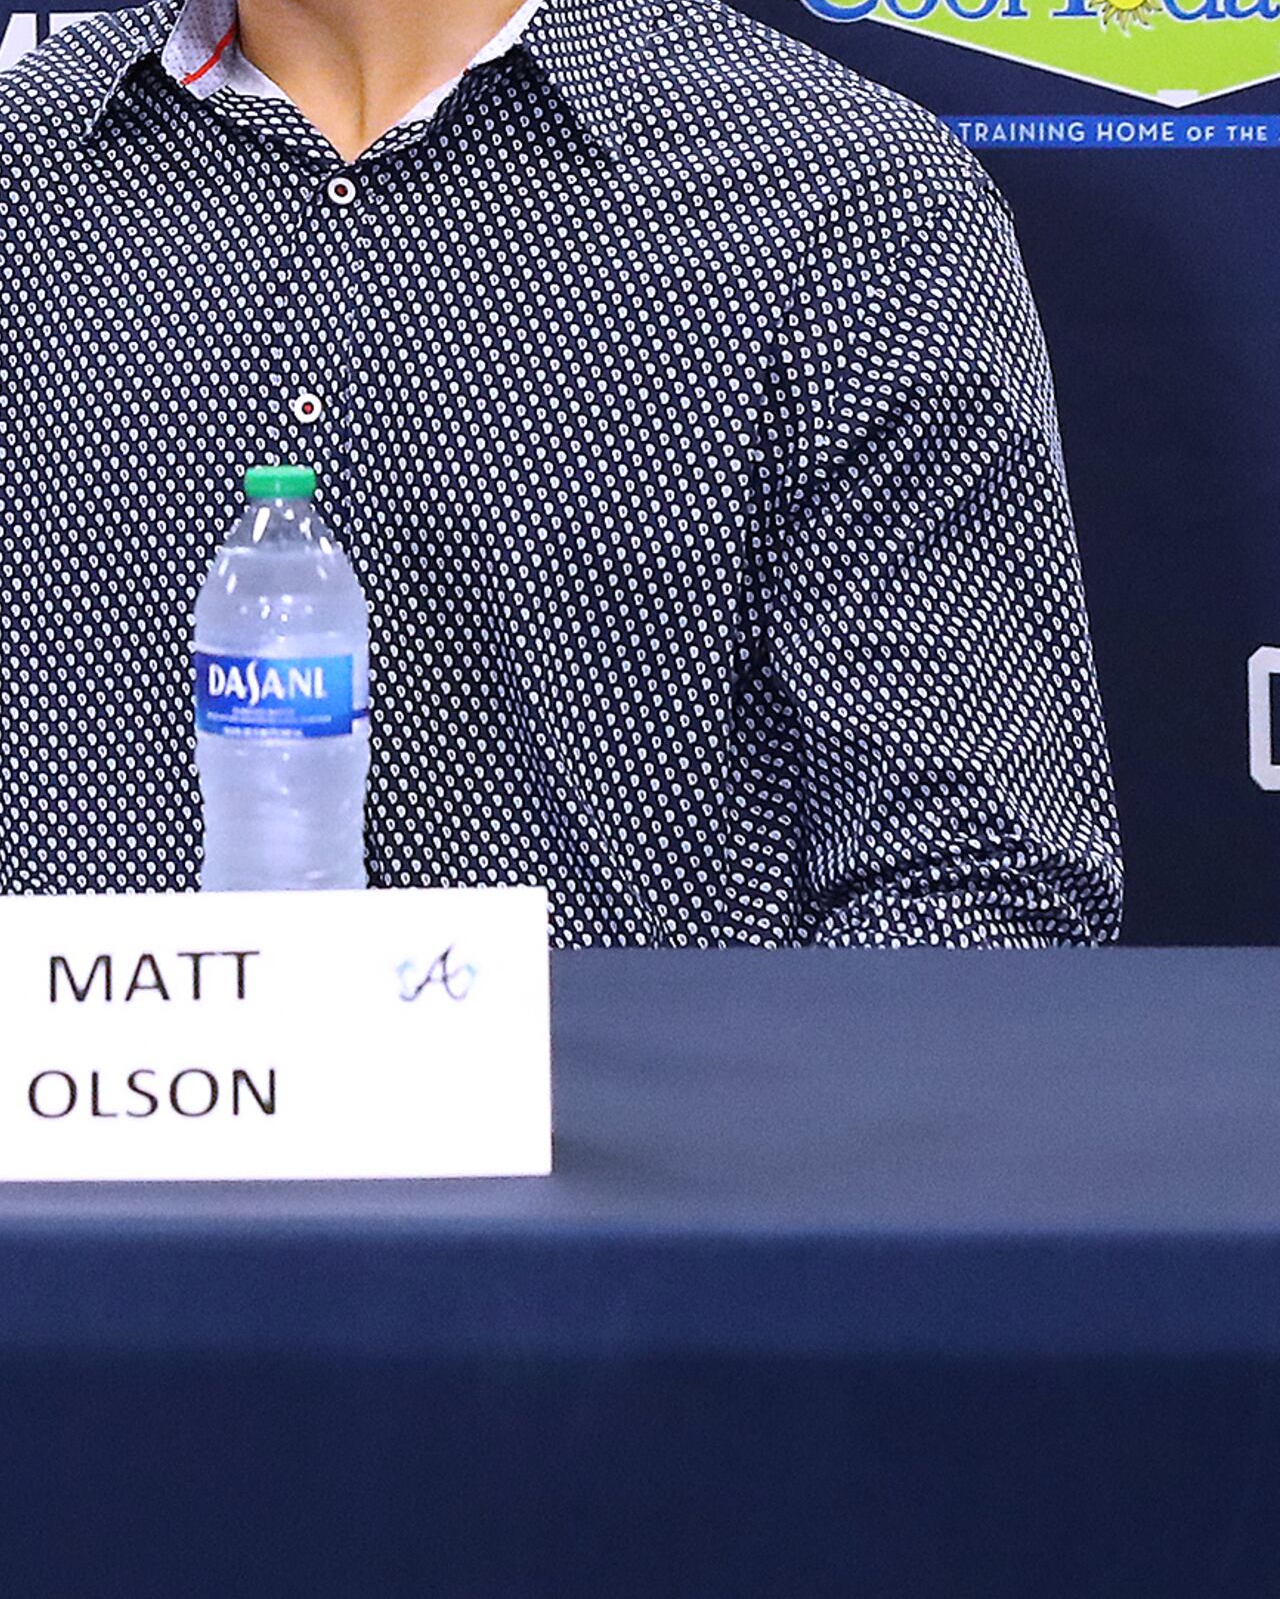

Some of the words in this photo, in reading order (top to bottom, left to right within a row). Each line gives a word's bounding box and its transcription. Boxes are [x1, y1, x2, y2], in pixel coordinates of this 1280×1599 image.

[959, 121, 1085, 142] TRAINING
[1097, 121, 1174, 142] HOME
[1186, 125, 1215, 141] OF
[1226, 125, 1267, 141] THE
[208, 658, 329, 706] DASANI
[48, 951, 261, 1004] MATT
[27, 1068, 277, 1119] OLSON
